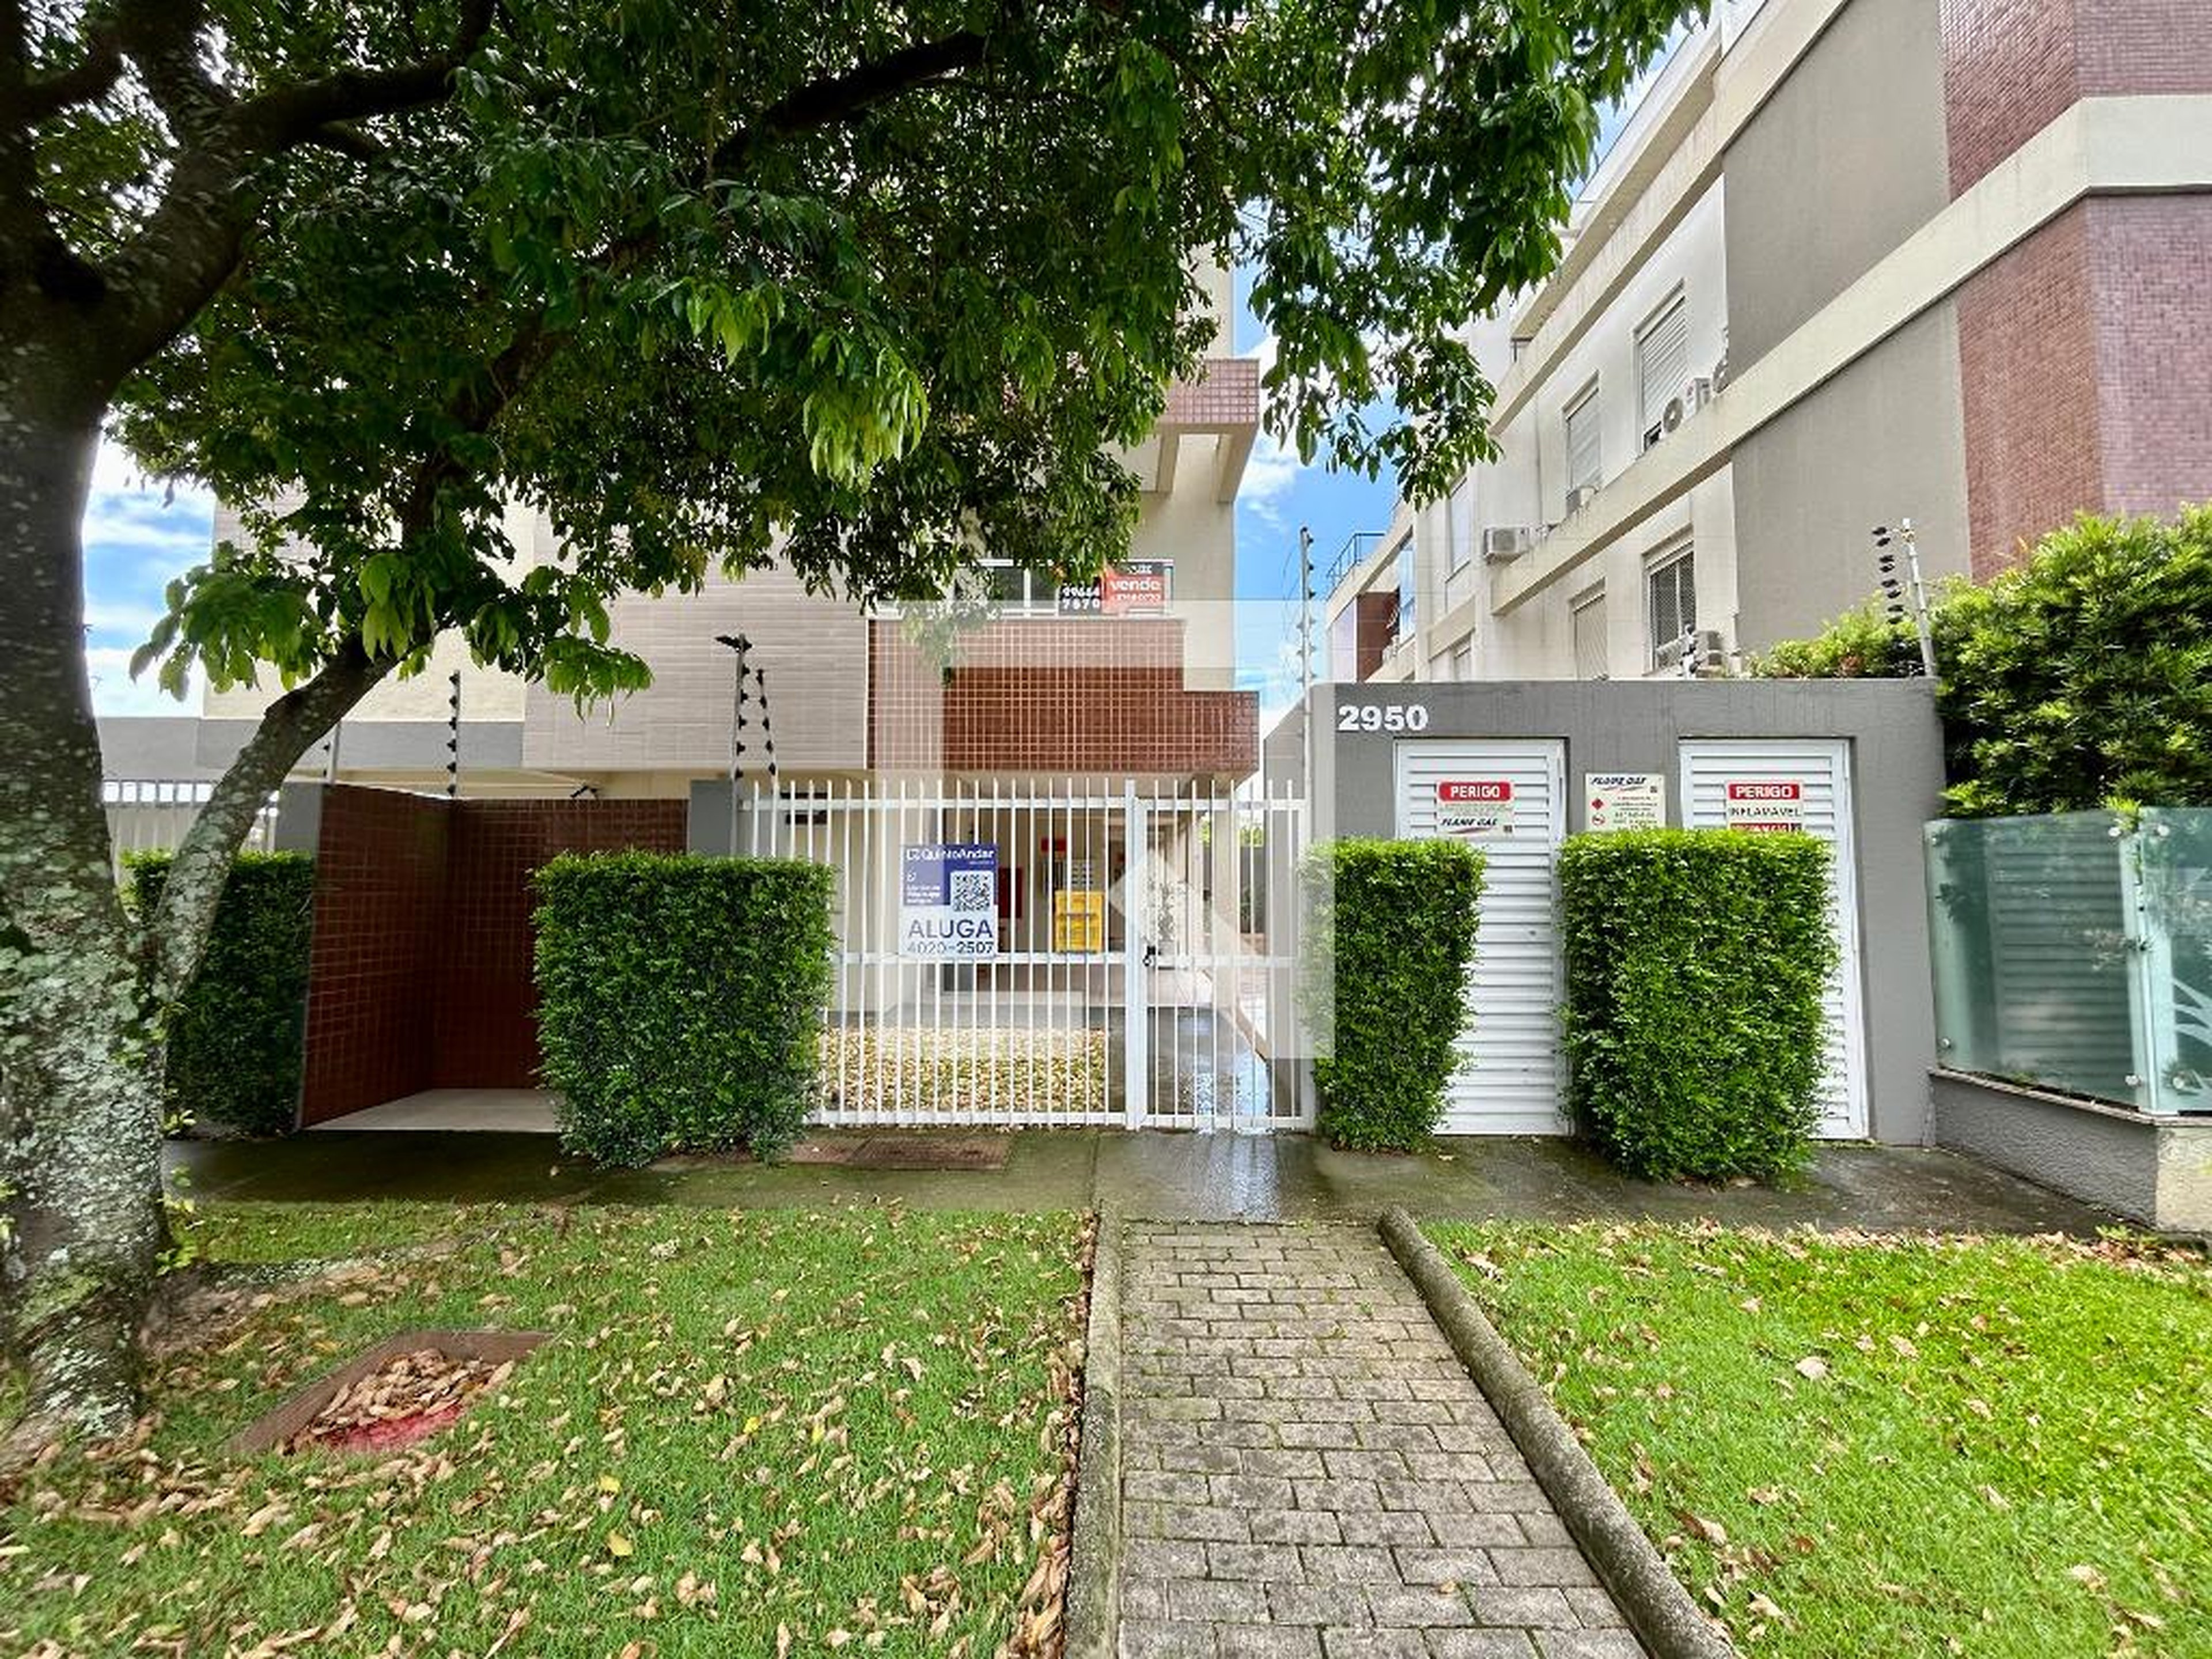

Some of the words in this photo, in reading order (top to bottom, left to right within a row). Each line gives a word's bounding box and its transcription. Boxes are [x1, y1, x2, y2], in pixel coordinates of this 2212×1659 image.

[1110, 578, 1161, 590] vende
[1338, 705, 1429, 731] 2950
[1450, 785, 1500, 798] PERIGO
[1736, 785, 1793, 798] PERIGO
[907, 919, 993, 938] ALUGA
[907, 941, 994, 955] 4020-2507
